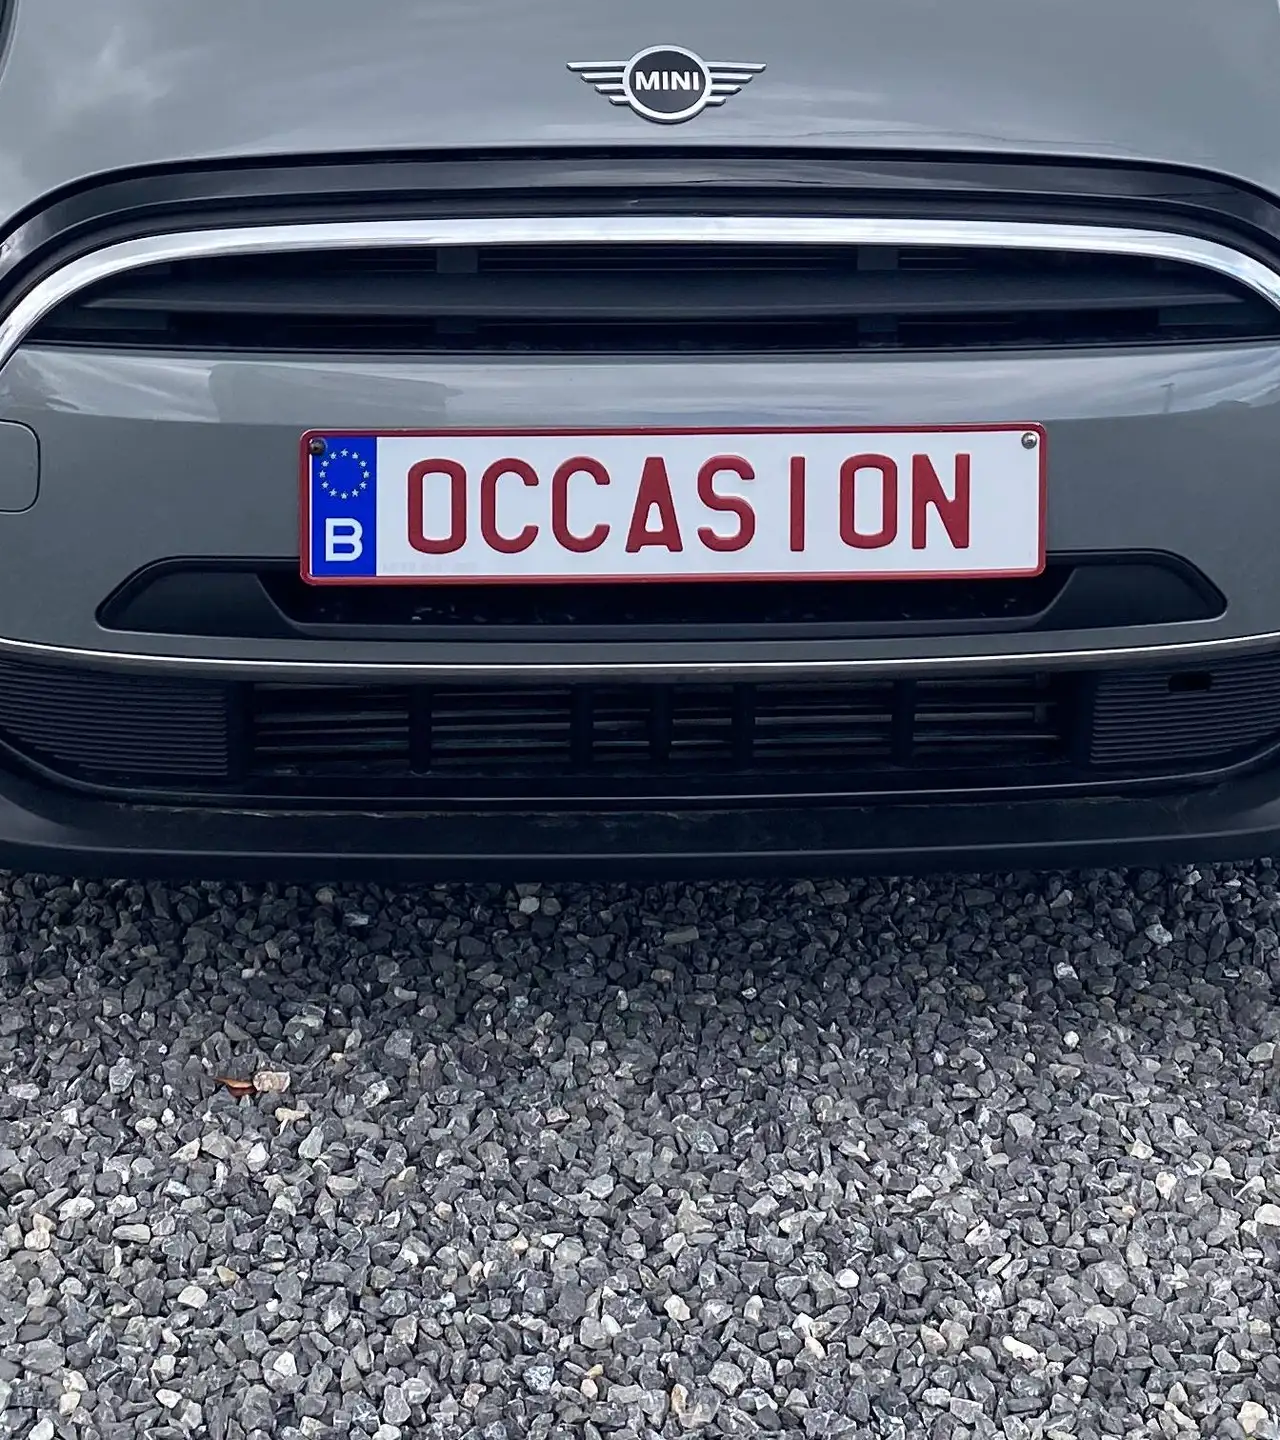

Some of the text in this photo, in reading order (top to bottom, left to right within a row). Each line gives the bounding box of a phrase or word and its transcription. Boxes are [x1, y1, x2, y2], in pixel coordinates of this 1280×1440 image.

[635, 71, 700, 91] MINI
[407, 453, 971, 554] OCCASION
[324, 517, 363, 562] B
